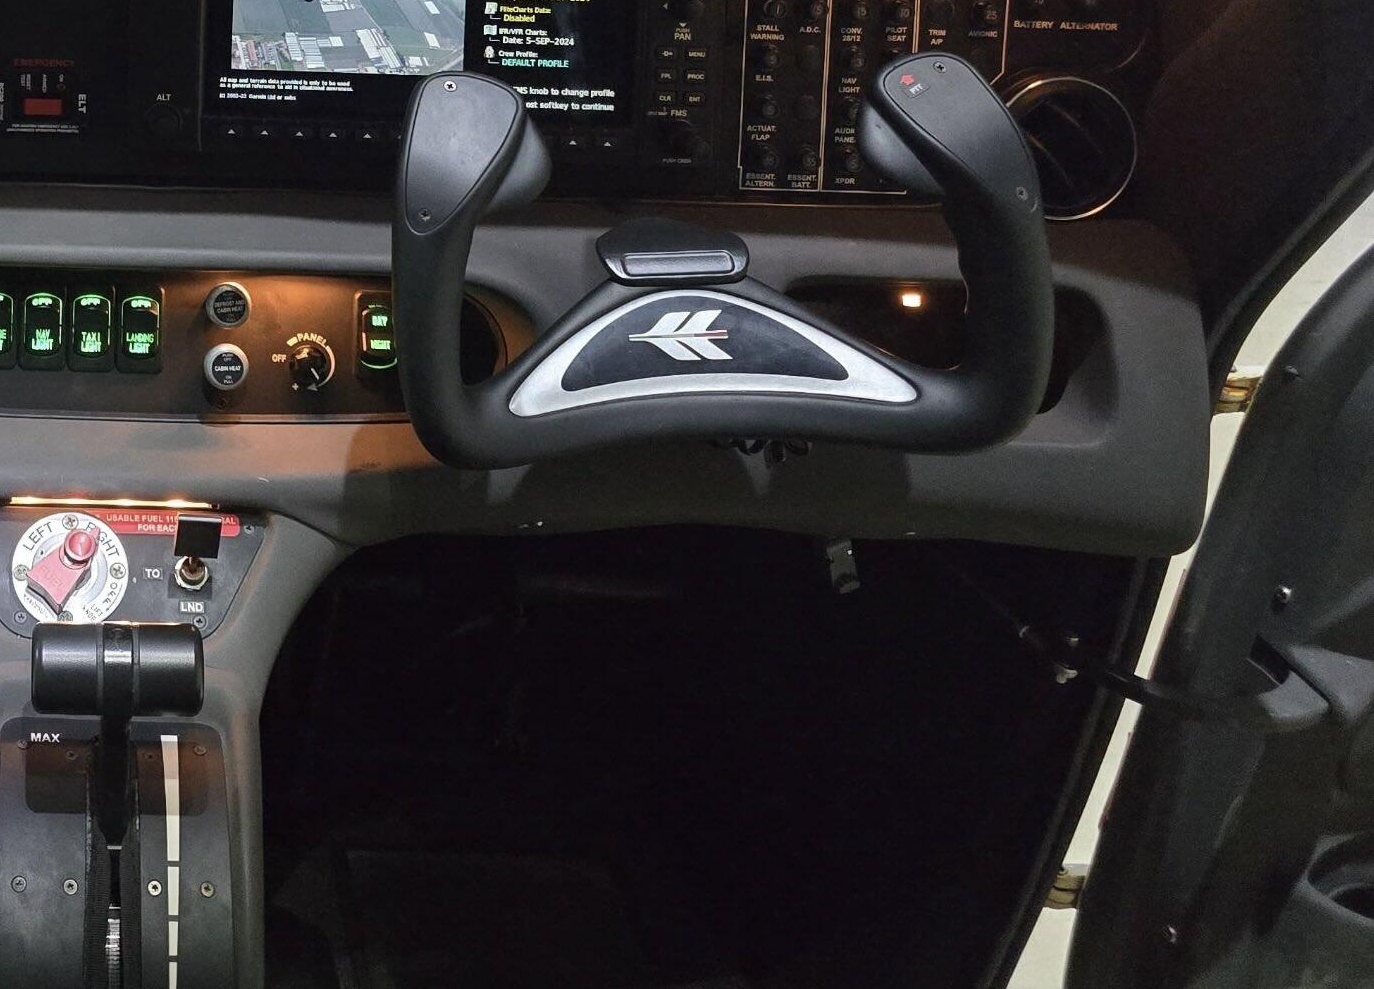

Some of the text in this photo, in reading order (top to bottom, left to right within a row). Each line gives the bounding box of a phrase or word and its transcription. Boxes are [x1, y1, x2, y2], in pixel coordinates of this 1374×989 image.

[1014, 20, 1118, 31] BATTERY ALTERNATOR
[502, 59, 535, 67] DEFAULT
[530, 87, 548, 95] knob
[561, 88, 589, 97] change
[591, 89, 615, 98] profile
[79, 94, 87, 113] ELT
[540, 102, 568, 110] softkey
[582, 103, 614, 111] continue
[82, 332, 100, 341] TAXI
[127, 333, 154, 343] LANDING
[297, 333, 328, 348] PANEL
[272, 354, 286, 362] OFF
[23, 522, 52, 550] LEFT
[86, 522, 119, 556] RGHT
[145, 569, 160, 578] TO
[102, 583, 118, 604] OFF
[180, 602, 204, 612] LND
[31, 732, 60, 743] MAX
